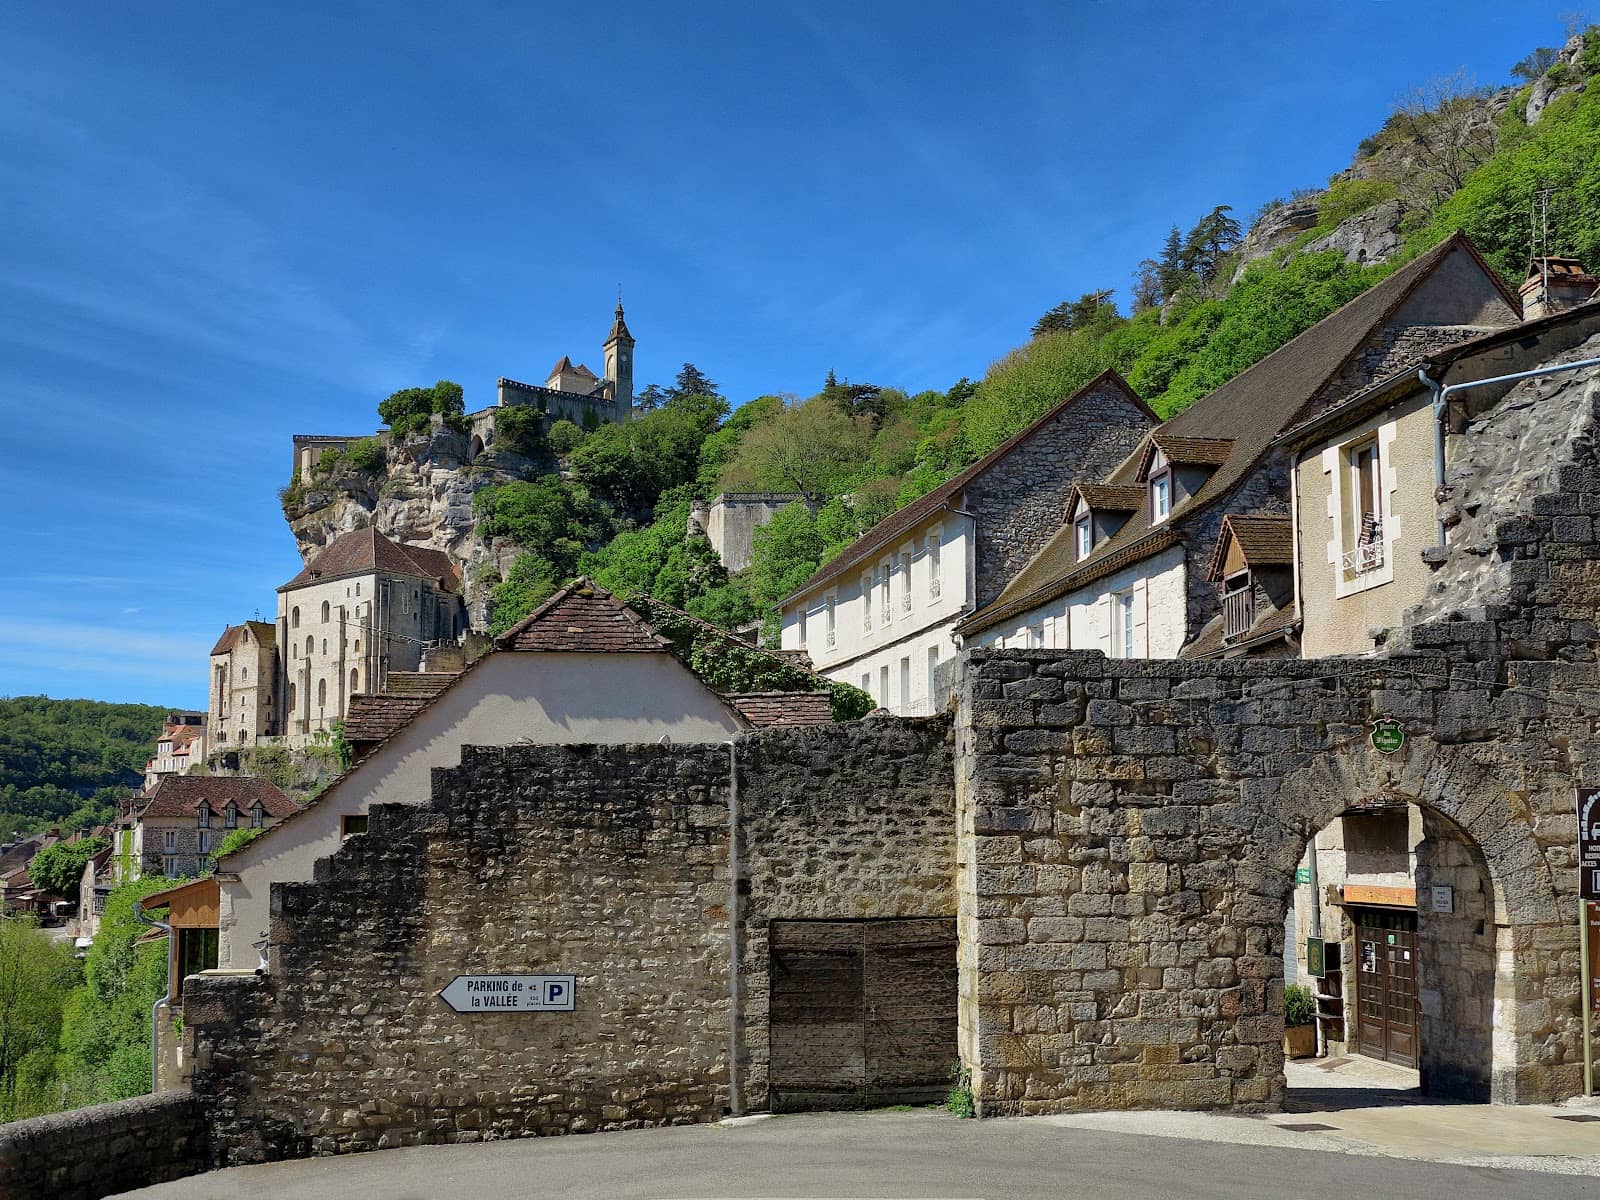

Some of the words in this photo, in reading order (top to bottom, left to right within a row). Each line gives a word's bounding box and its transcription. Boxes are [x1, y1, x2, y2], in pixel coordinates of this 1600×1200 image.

[467, 980, 509, 992] PARKING
[511, 980, 523, 992] de
[549, 984, 563, 1001] P
[471, 995, 480, 1007] la
